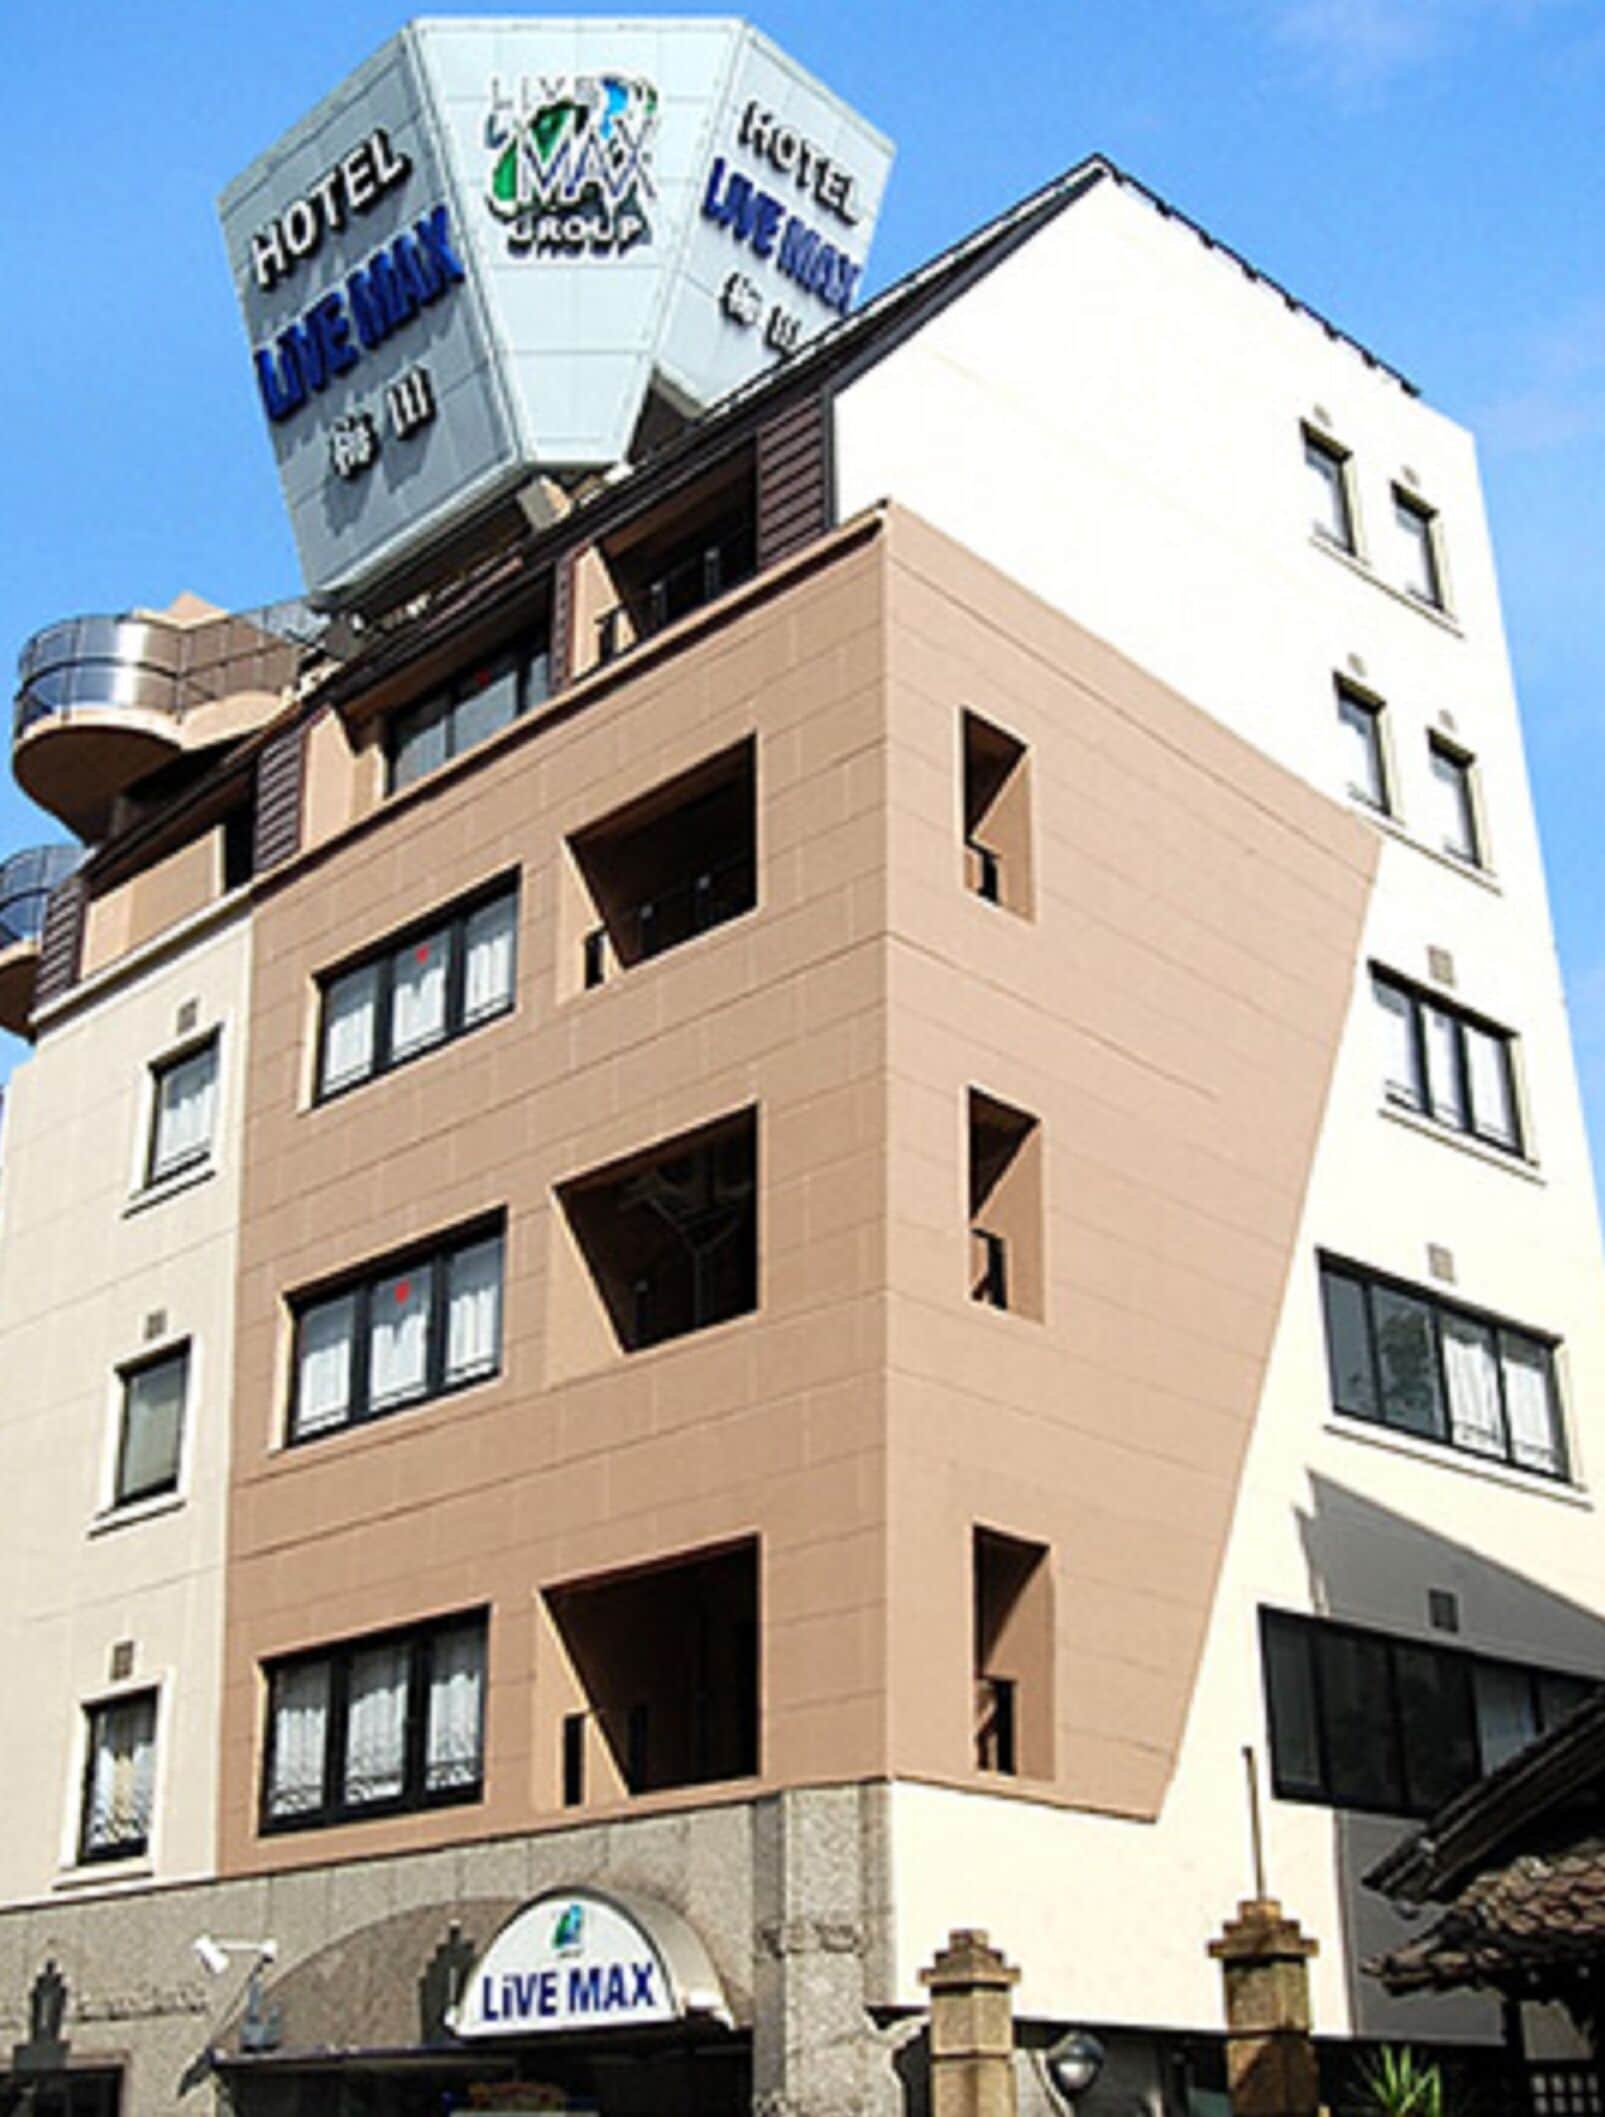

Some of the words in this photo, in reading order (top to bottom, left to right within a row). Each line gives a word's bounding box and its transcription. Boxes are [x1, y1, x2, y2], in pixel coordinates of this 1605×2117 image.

[252, 130, 410, 289] HOTEL
[521, 115, 656, 200] MAX
[738, 99, 862, 227] HOTEL
[346, 204, 464, 349] MAX
[508, 211, 648, 254] GROUP
[568, 1961, 655, 2014] MAX
